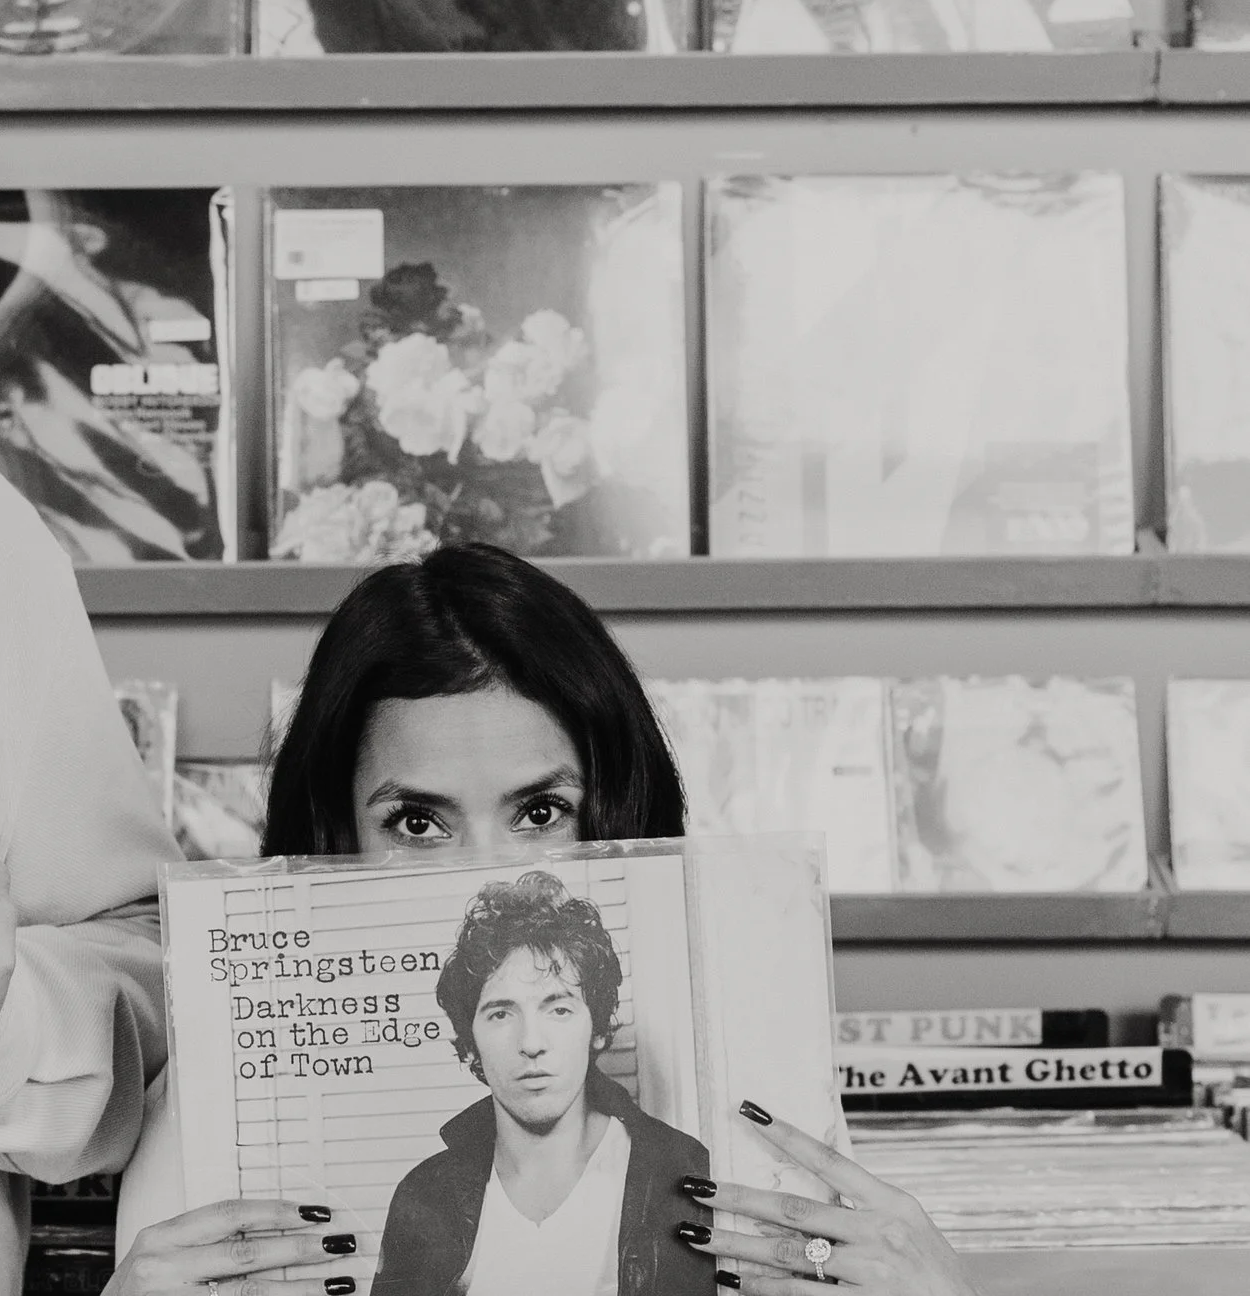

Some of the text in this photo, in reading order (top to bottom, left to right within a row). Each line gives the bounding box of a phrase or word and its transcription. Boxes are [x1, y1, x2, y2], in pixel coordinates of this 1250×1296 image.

[208, 929, 310, 953] Bruce
[210, 950, 441, 987] Springsteen
[233, 993, 400, 1021] Darkness
[237, 1018, 440, 1049] on the Edge
[909, 1013, 1039, 1043] PUNK
[239, 1054, 374, 1079] of Town
[898, 1060, 1013, 1087] Avant
[1024, 1058, 1153, 1083] Ghetto
